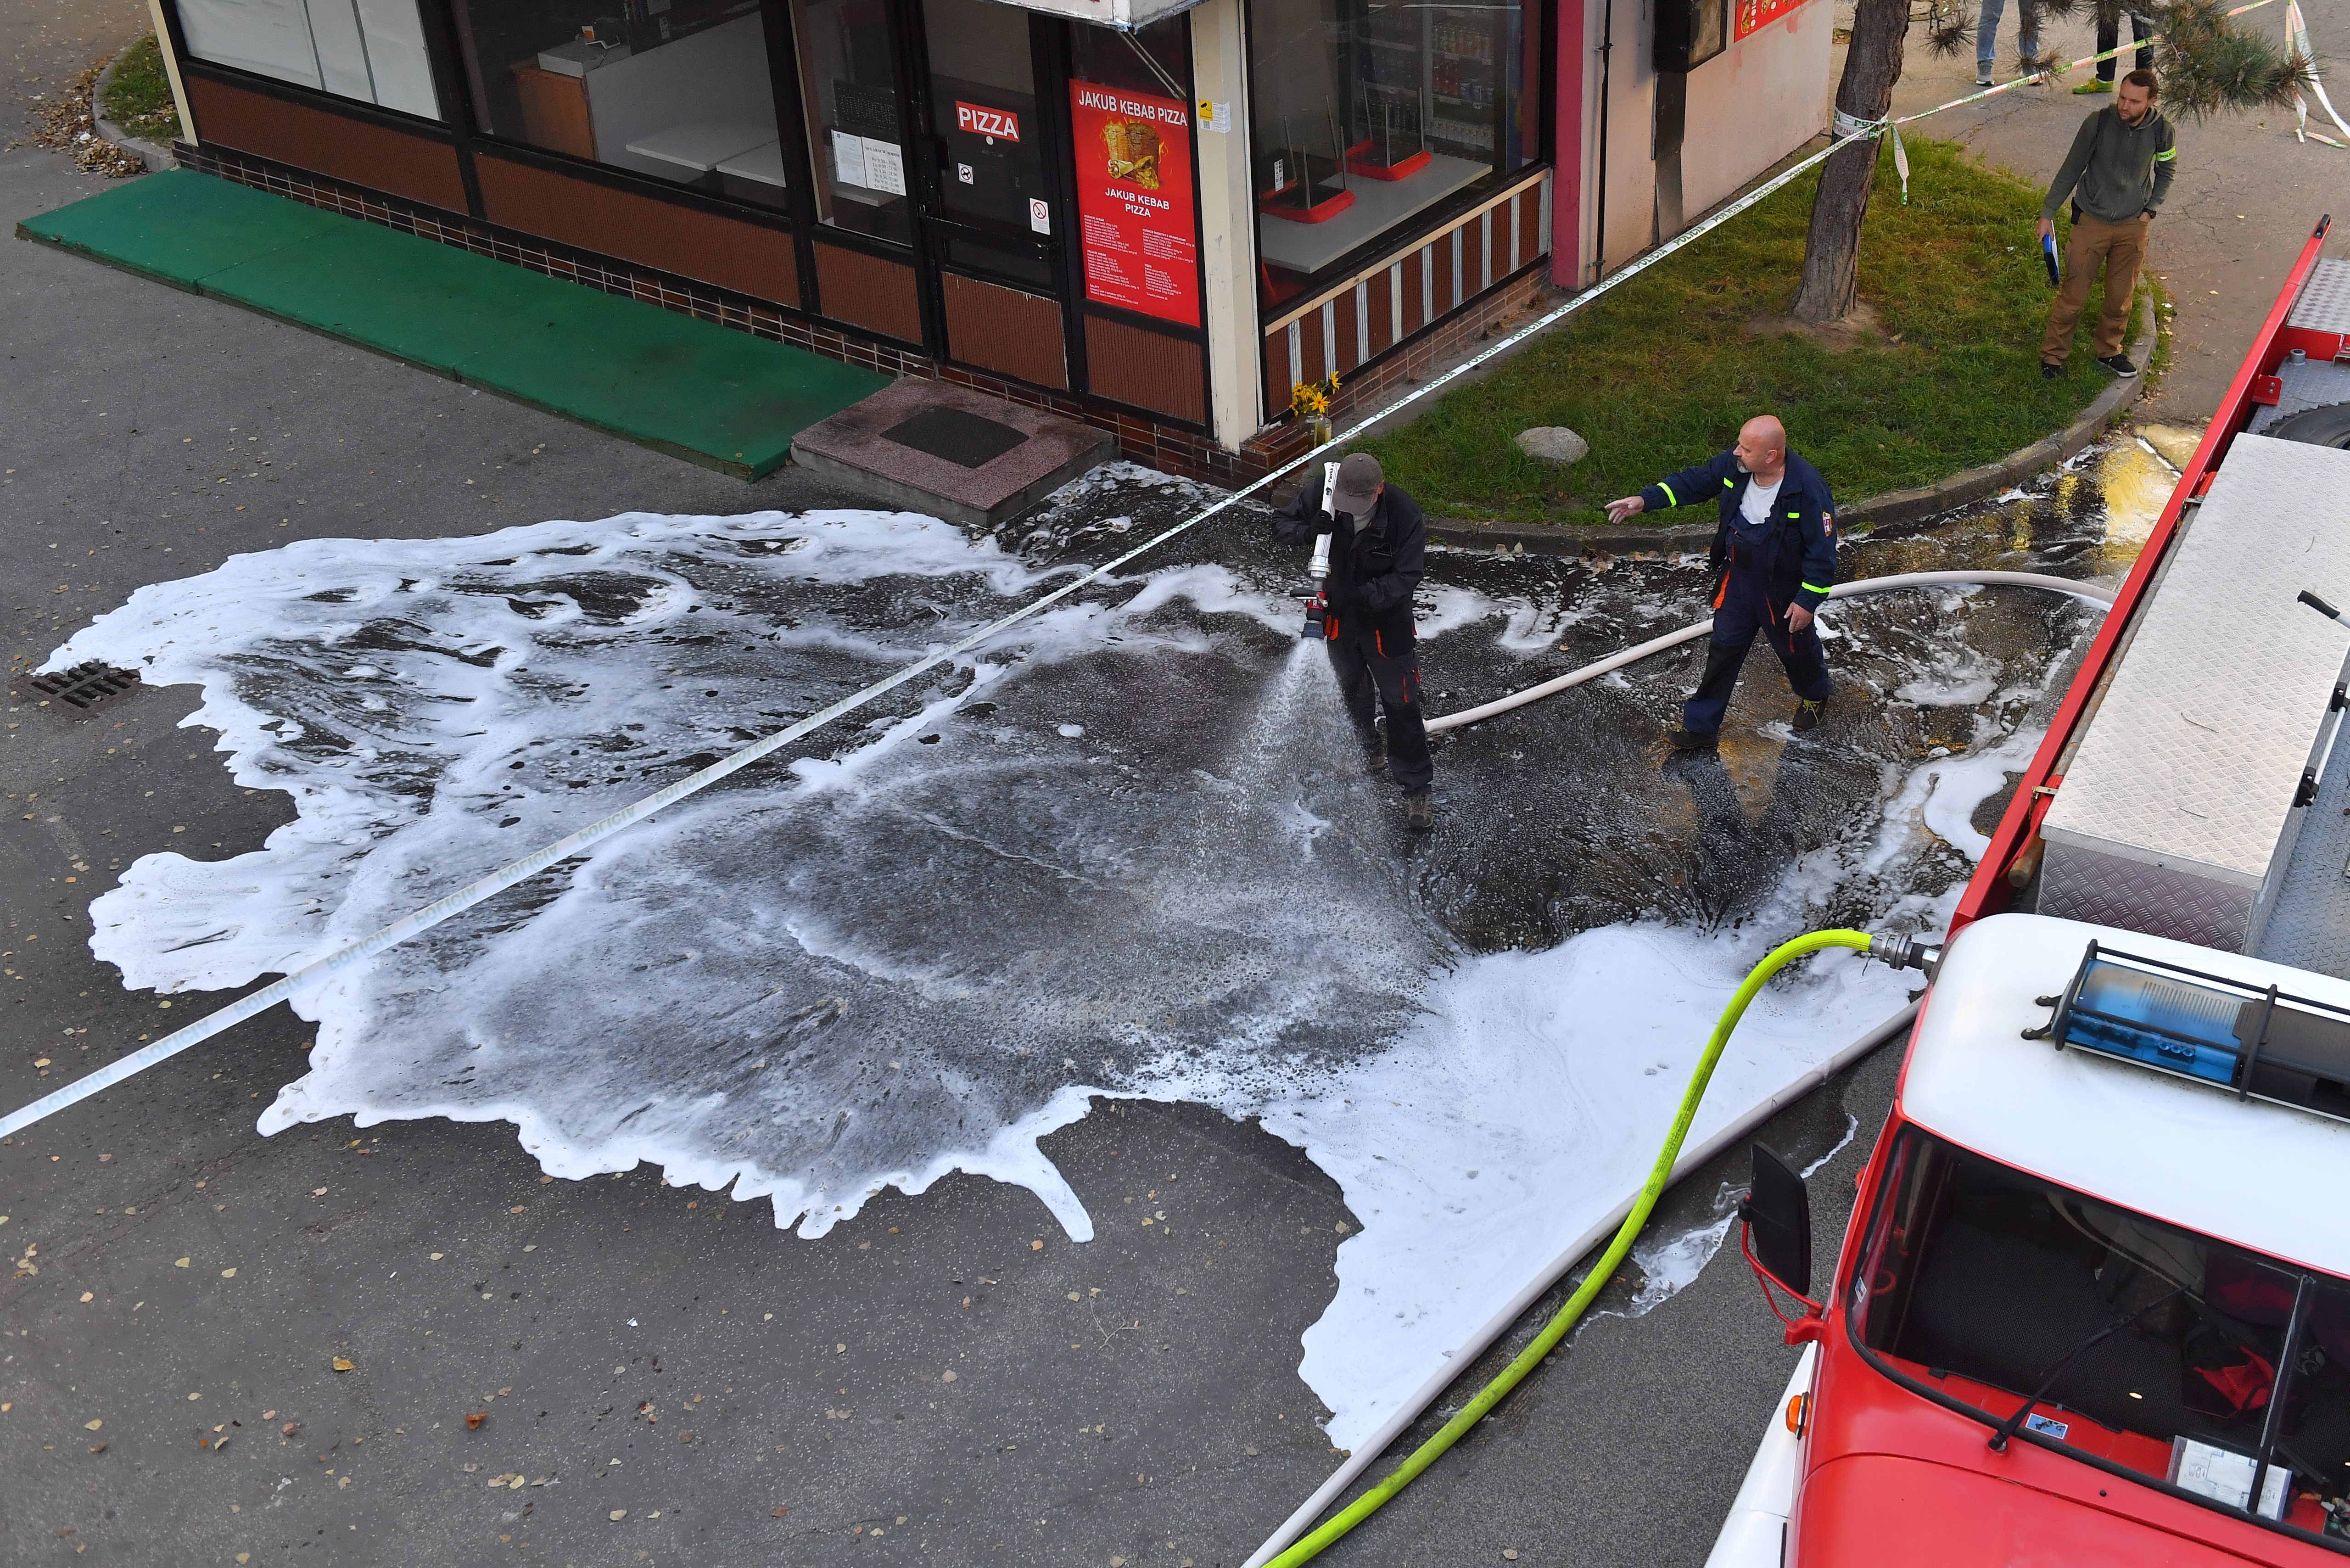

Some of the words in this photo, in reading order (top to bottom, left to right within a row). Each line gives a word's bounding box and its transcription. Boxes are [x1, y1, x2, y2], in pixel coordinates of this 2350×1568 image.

[1079, 90, 1117, 112] JAKUB
[1120, 100, 1155, 120] KEBAB
[1158, 107, 1187, 126] PIZZA
[959, 107, 1018, 139] PIZZA
[1105, 187, 1136, 202] JAKUB
[1138, 194, 1169, 210] KEBAB
[1125, 203, 1151, 218] PIZZA
